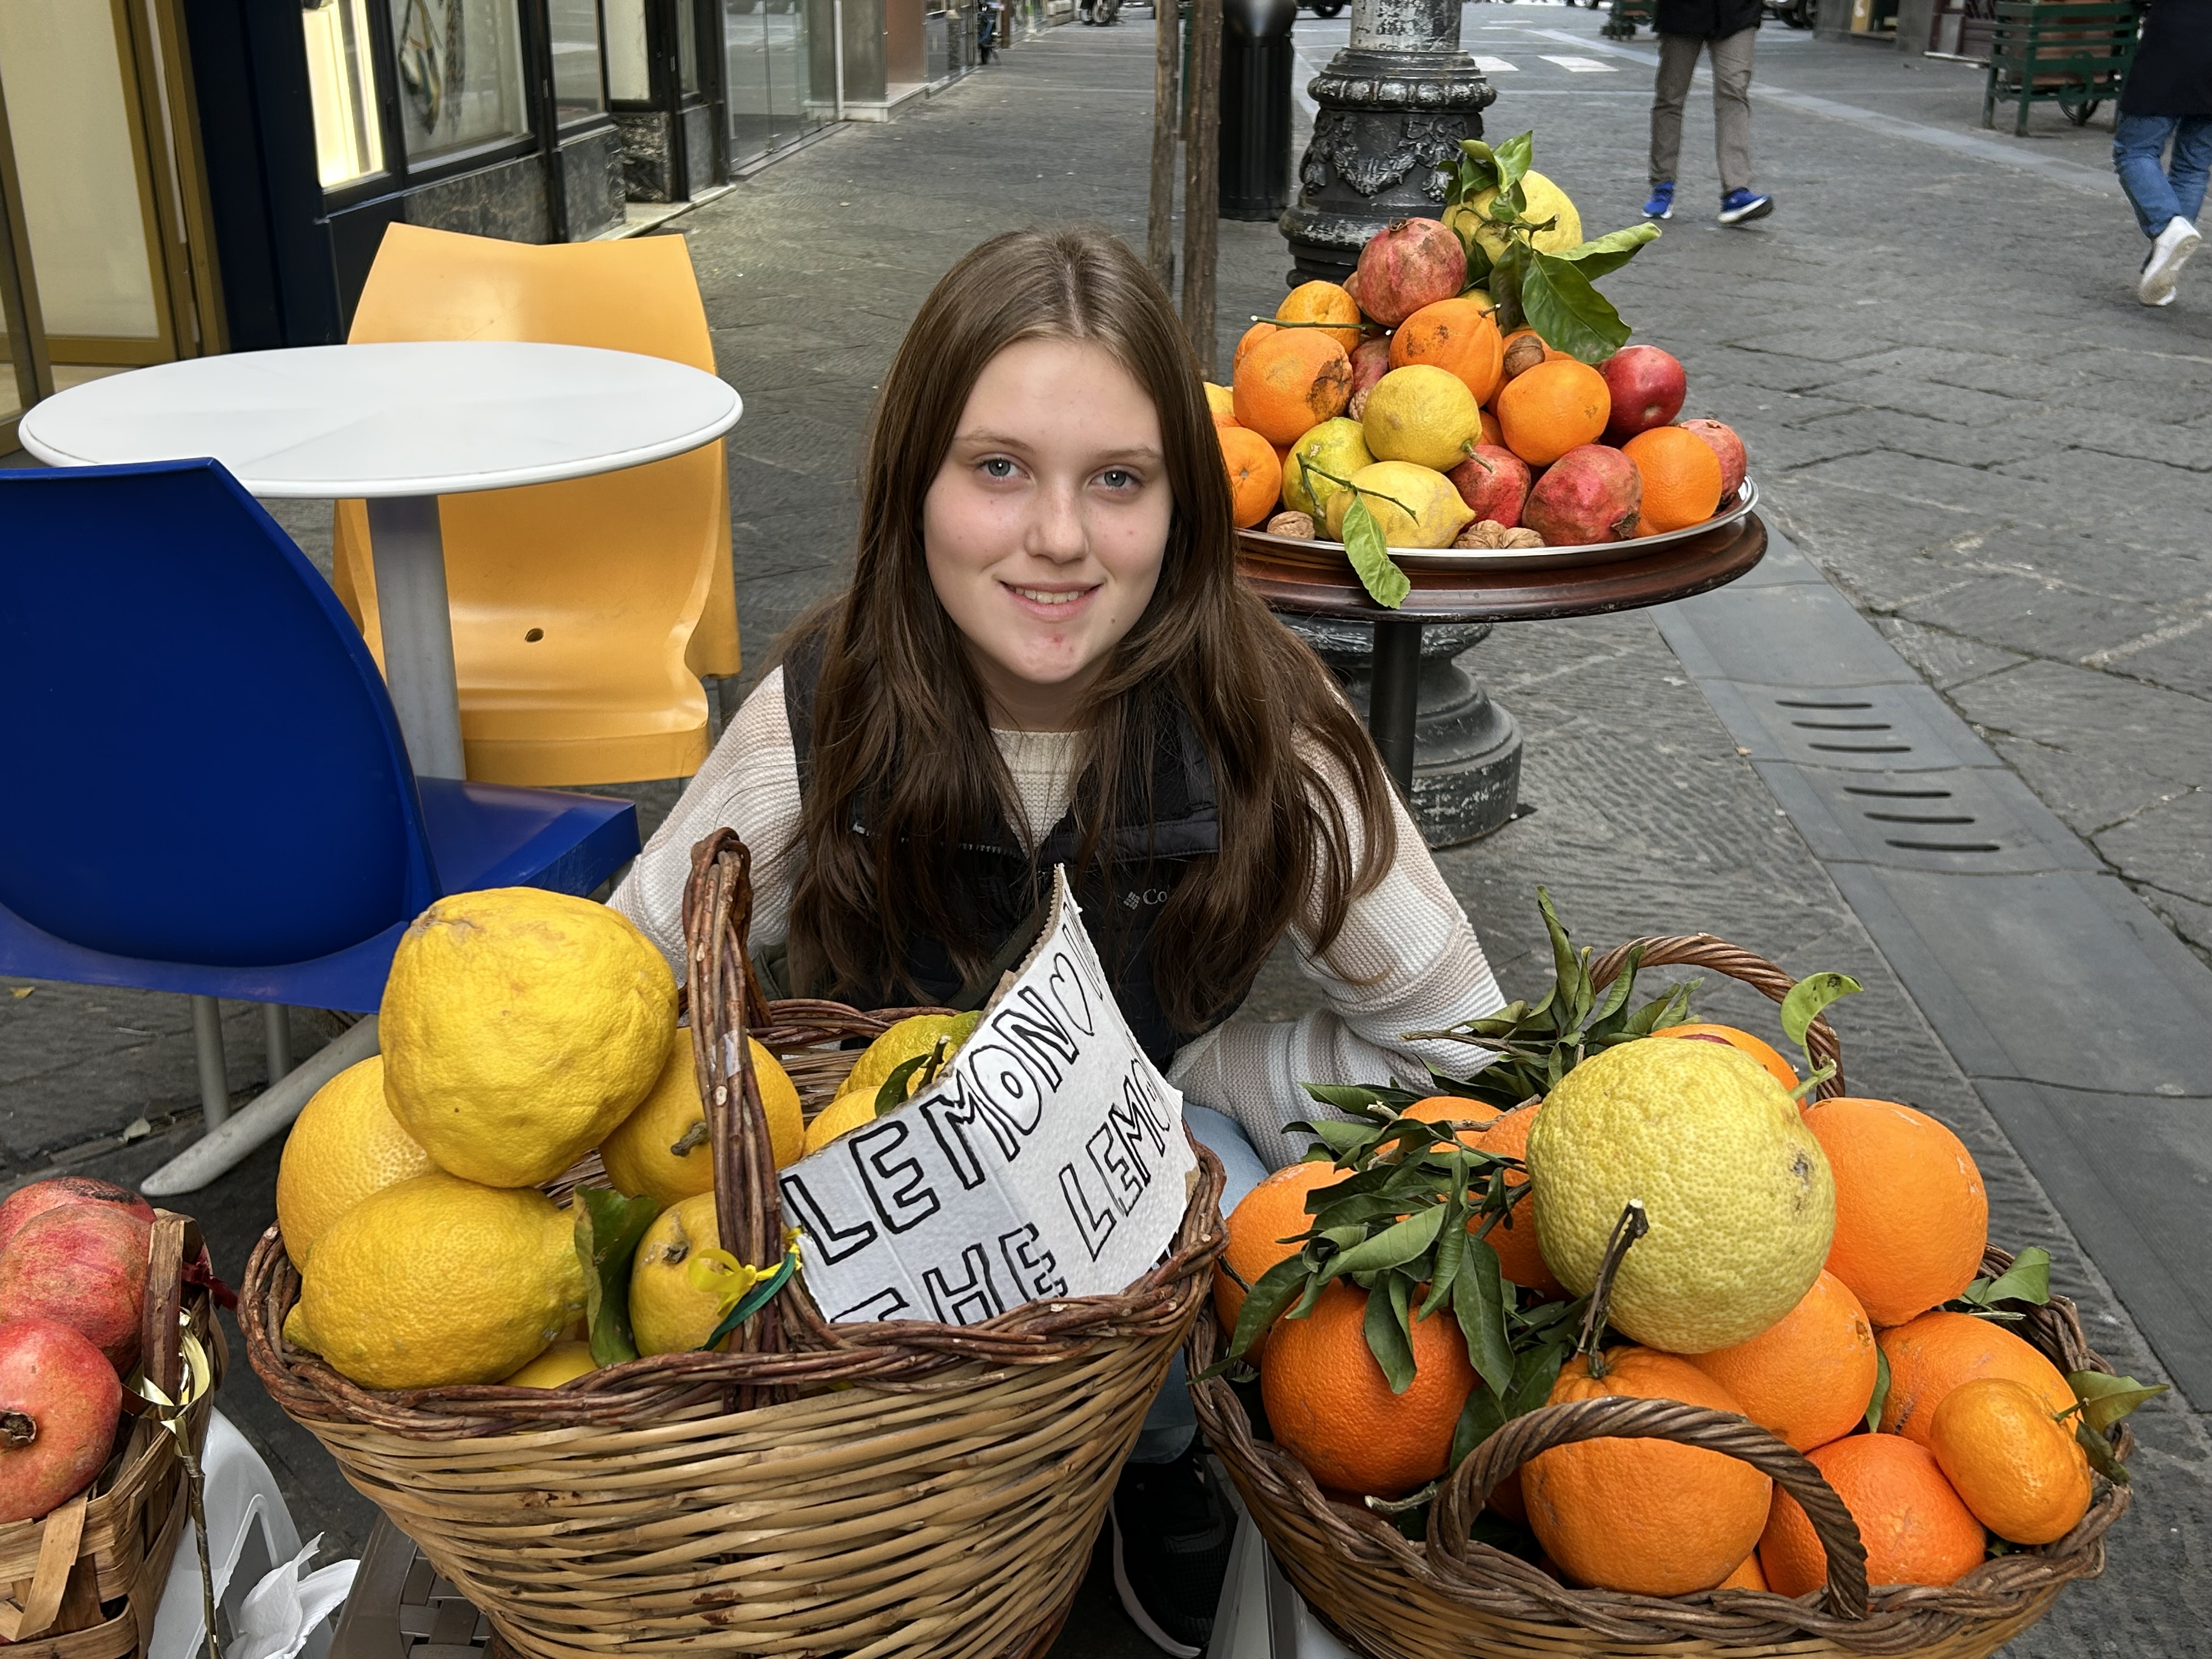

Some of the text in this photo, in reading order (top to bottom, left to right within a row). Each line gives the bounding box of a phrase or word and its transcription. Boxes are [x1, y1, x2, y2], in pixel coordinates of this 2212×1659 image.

[1142, 888, 1168, 905] Co
[780, 985, 1080, 1265] LEMON
[1059, 1031, 1171, 1262] LEMO
